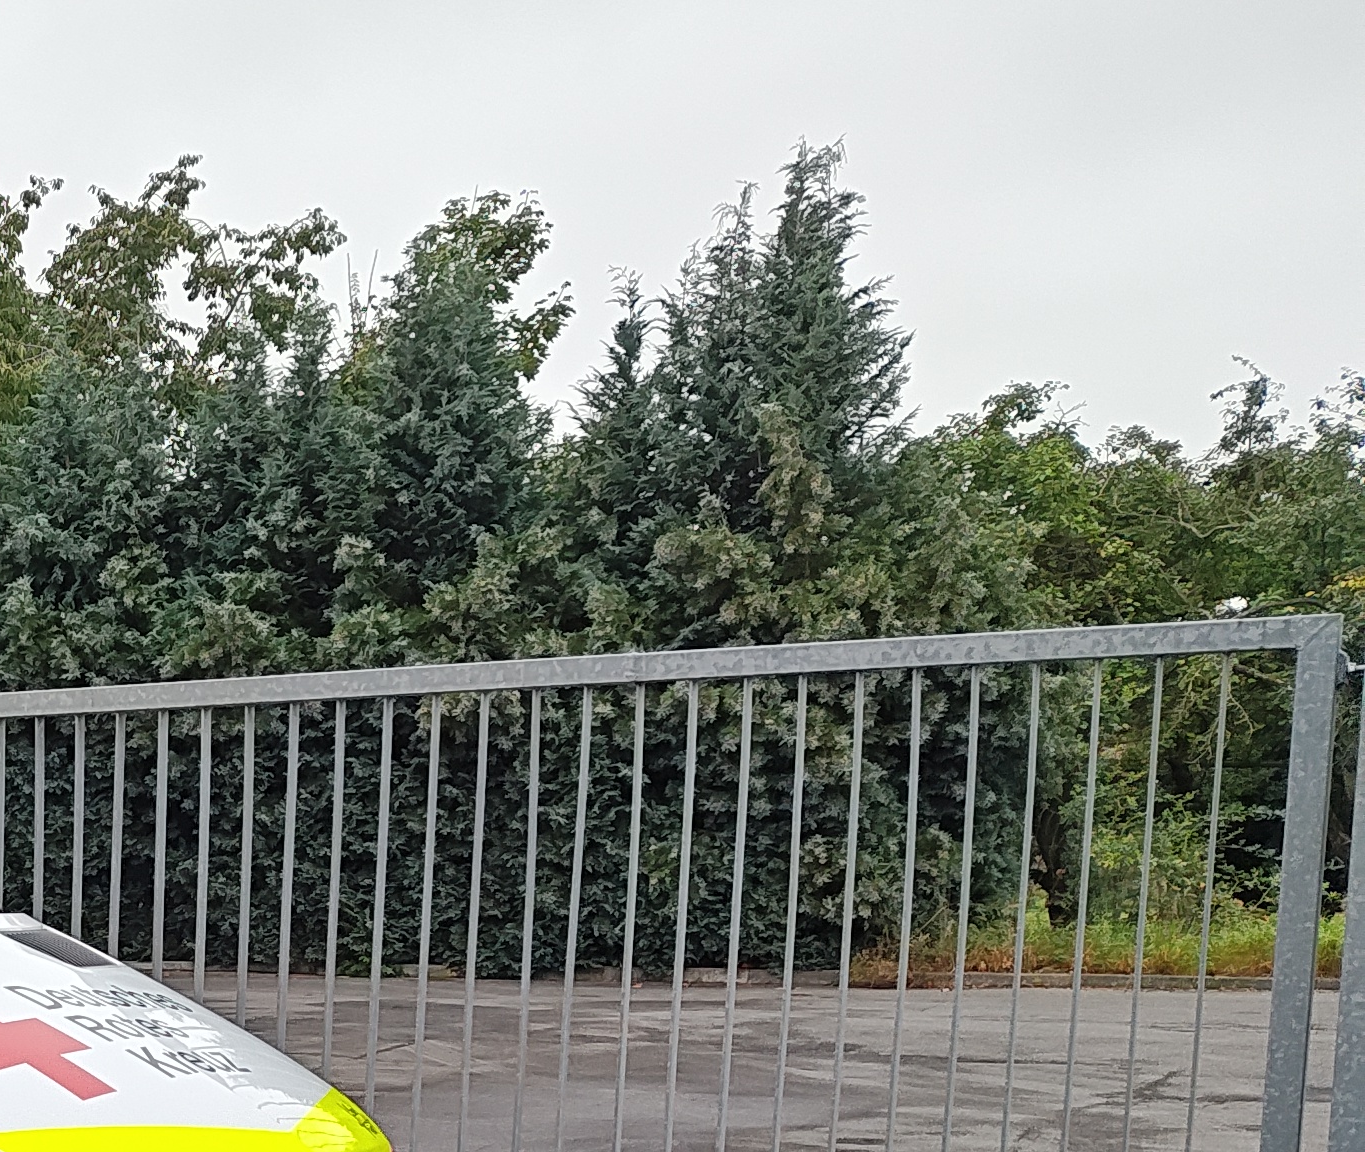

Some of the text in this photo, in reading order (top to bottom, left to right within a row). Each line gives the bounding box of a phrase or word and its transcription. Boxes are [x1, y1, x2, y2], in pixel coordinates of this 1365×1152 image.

[3, 984, 194, 1013] Deutsches
[64, 1013, 190, 1043] Rotes
[125, 1046, 253, 1079] Kreuz
